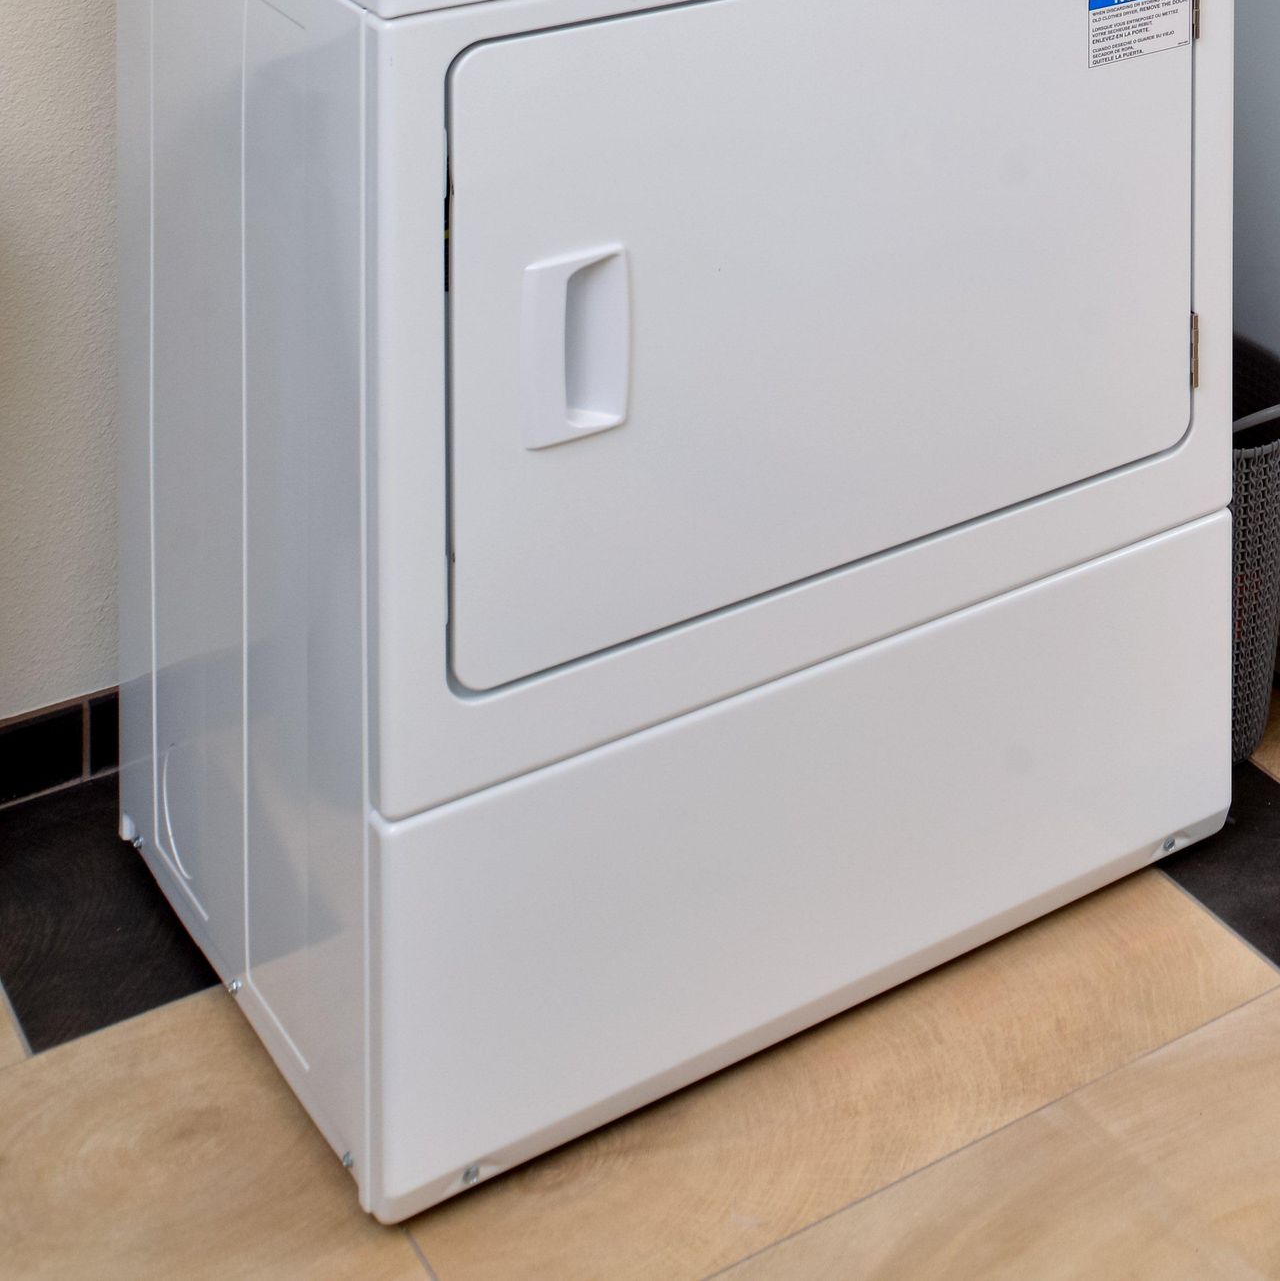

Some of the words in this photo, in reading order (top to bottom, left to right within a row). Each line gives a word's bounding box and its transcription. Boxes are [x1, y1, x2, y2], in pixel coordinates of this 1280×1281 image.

[1102, 12, 1122, 21] CLOTHES
[1140, 4, 1160, 12] REMOVE
[1106, 4, 1133, 14] DISCARDING
[1092, 24, 1113, 33] LORSQUE
[1126, 15, 1154, 25] ENTREPOSEZ
[1162, 9, 1179, 17] METTEZ
[1092, 33, 1124, 44] ENLEVEZ-EN
[1092, 45, 1111, 53] CUANDO
[1112, 40, 1132, 48] DESECHE
[1137, 35, 1155, 43] GUARDE
[1092, 50, 1114, 59] SECADOR
[1092, 56, 1114, 65] QUITELE
